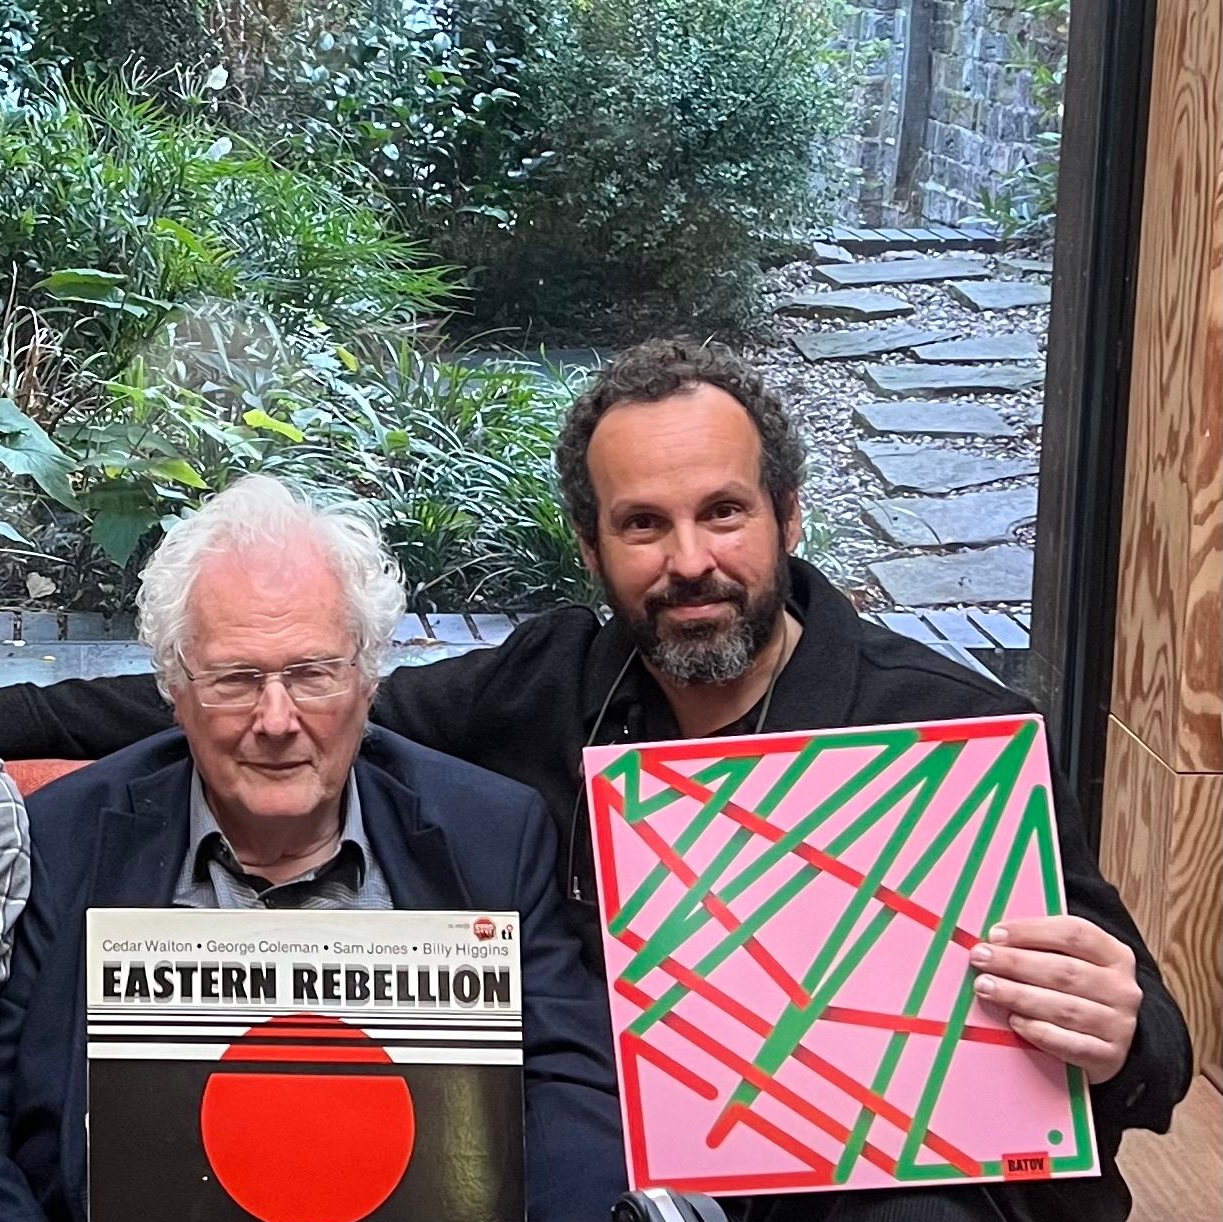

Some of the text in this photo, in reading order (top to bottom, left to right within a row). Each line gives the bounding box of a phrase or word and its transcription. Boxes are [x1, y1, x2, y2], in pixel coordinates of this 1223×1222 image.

[102, 939, 509, 958] Cedar Walton George Coleman Sam Jones Billy Higgins
[103, 959, 512, 1008] EASTERN REBELLION
